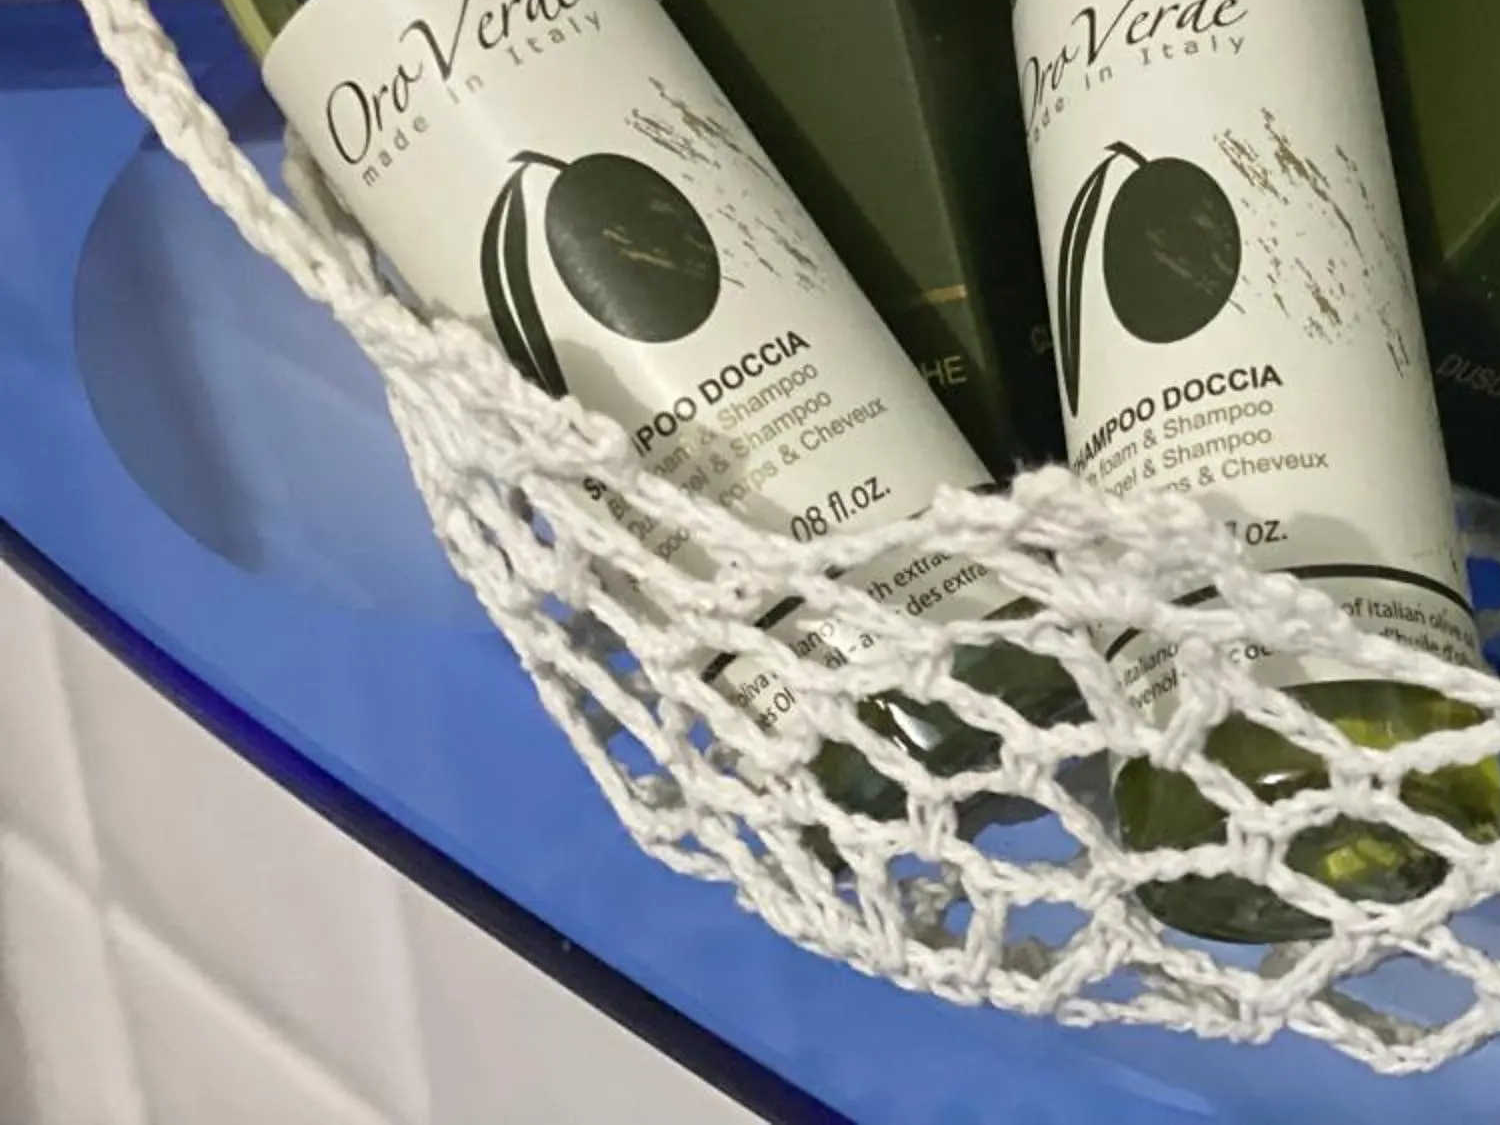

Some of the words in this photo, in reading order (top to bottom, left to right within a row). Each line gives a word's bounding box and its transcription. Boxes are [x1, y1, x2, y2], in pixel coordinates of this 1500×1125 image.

[1086, 65, 1113, 92] in
[1140, 35, 1245, 66] Italy
[362, 114, 430, 187] made
[447, 74, 484, 105] in
[505, 11, 602, 66] Italy
[698, 330, 812, 405] DOCCIA
[717, 362, 818, 430] Shampoo
[1162, 364, 1284, 412] DOCCIA
[712, 453, 731, 475] &
[730, 391, 832, 457] Shampoo
[779, 442, 801, 465] &
[799, 398, 889, 452] Cheveux
[1143, 429, 1158, 450] &
[1163, 398, 1274, 441] Shampoo
[1143, 459, 1156, 481] &
[1163, 428, 1273, 471] Shampoo
[1222, 451, 1330, 479] Cheveux
[906, 585, 943, 617] des
[944, 562, 991, 594] extra
